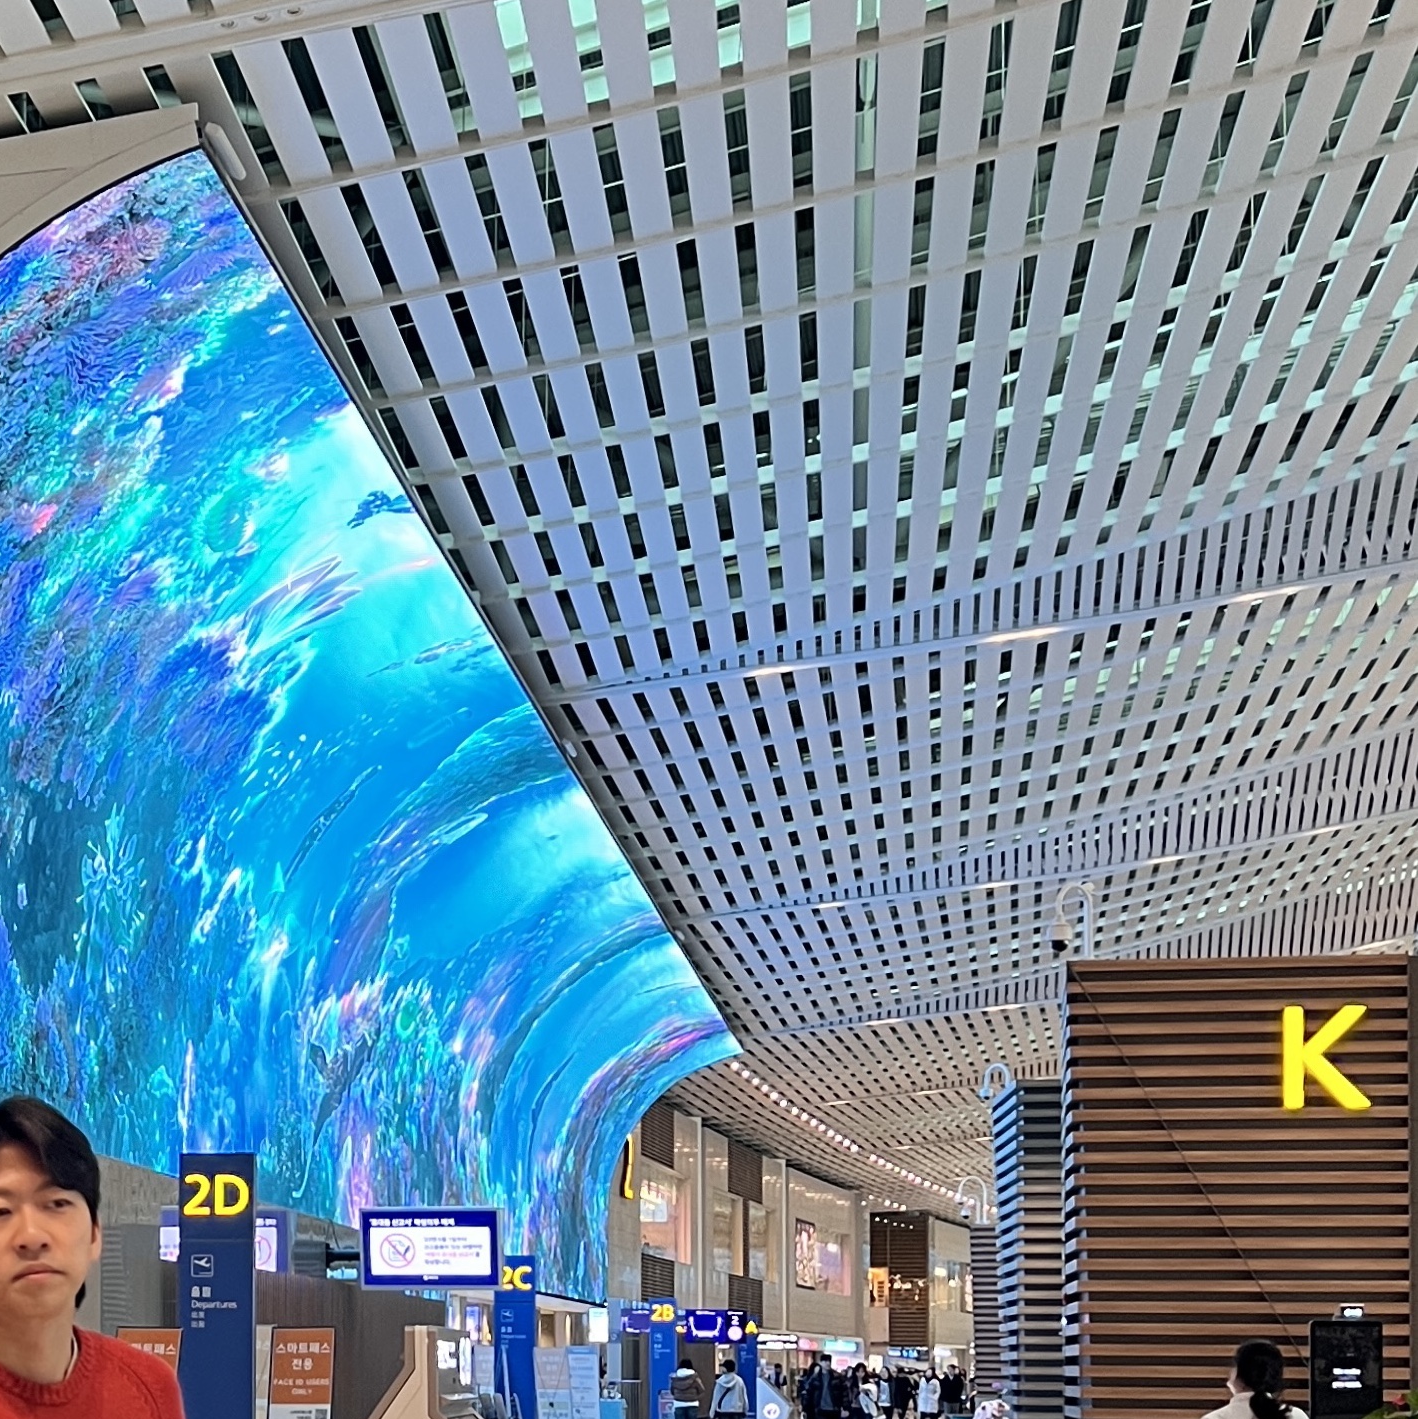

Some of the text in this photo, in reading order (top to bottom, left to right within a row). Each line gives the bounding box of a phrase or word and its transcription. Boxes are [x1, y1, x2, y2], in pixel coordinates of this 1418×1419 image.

[1283, 1005, 1372, 1110] K
[183, 1174, 250, 1216] 2D
[191, 1300, 237, 1310] Departures
[651, 1304, 675, 1322] 2B
[745, 1320, 758, 1334] A
[130, 1343, 176, 1355] 트패스
[276, 1342, 330, 1354] 스마트패스
